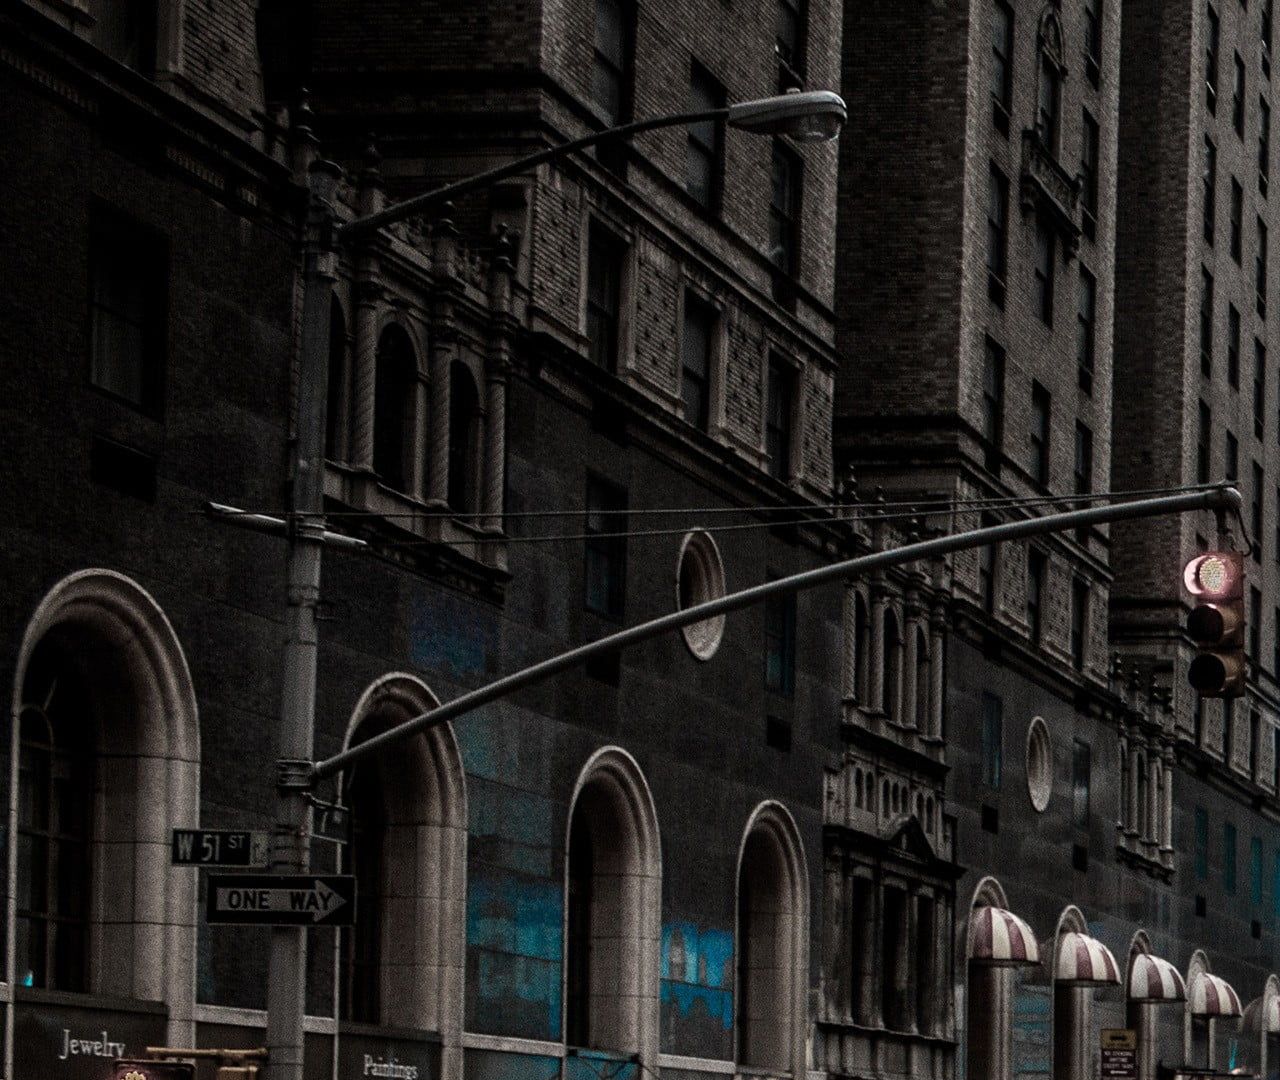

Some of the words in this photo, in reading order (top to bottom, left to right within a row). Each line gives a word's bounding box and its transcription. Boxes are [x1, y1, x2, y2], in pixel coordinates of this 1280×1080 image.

[177, 833, 194, 861] W
[202, 834, 220, 862] 51
[228, 835, 246, 849] ST
[228, 890, 270, 909] ONE
[290, 891, 334, 911] WAY
[59, 1028, 126, 1060] Jewelry
